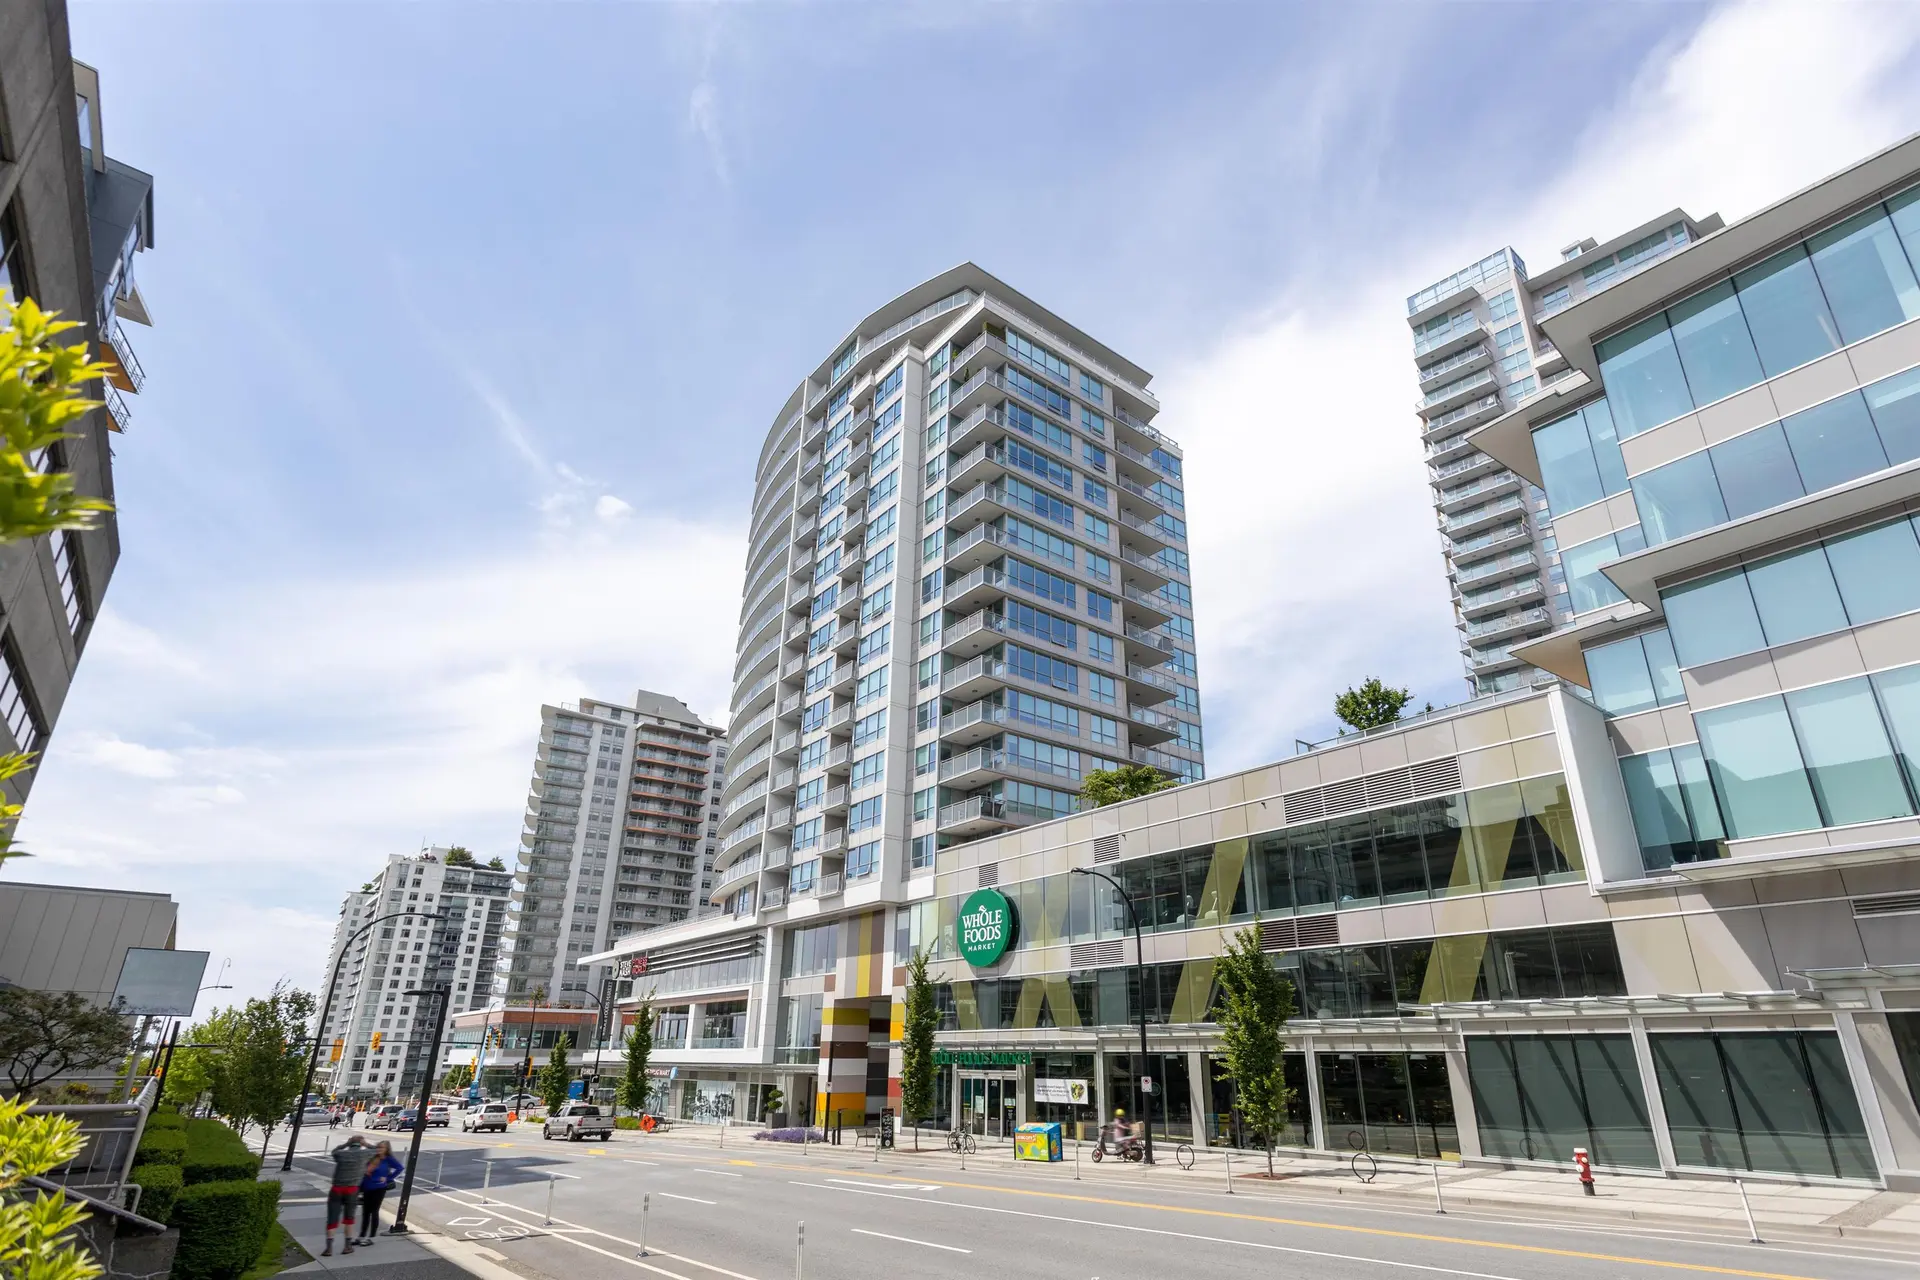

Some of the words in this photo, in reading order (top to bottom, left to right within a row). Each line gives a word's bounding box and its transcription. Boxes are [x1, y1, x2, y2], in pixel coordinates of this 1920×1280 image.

[962, 906, 1003, 929] WHOLE
[963, 925, 1002, 944] FOODS
[967, 942, 996, 952] MARKET
